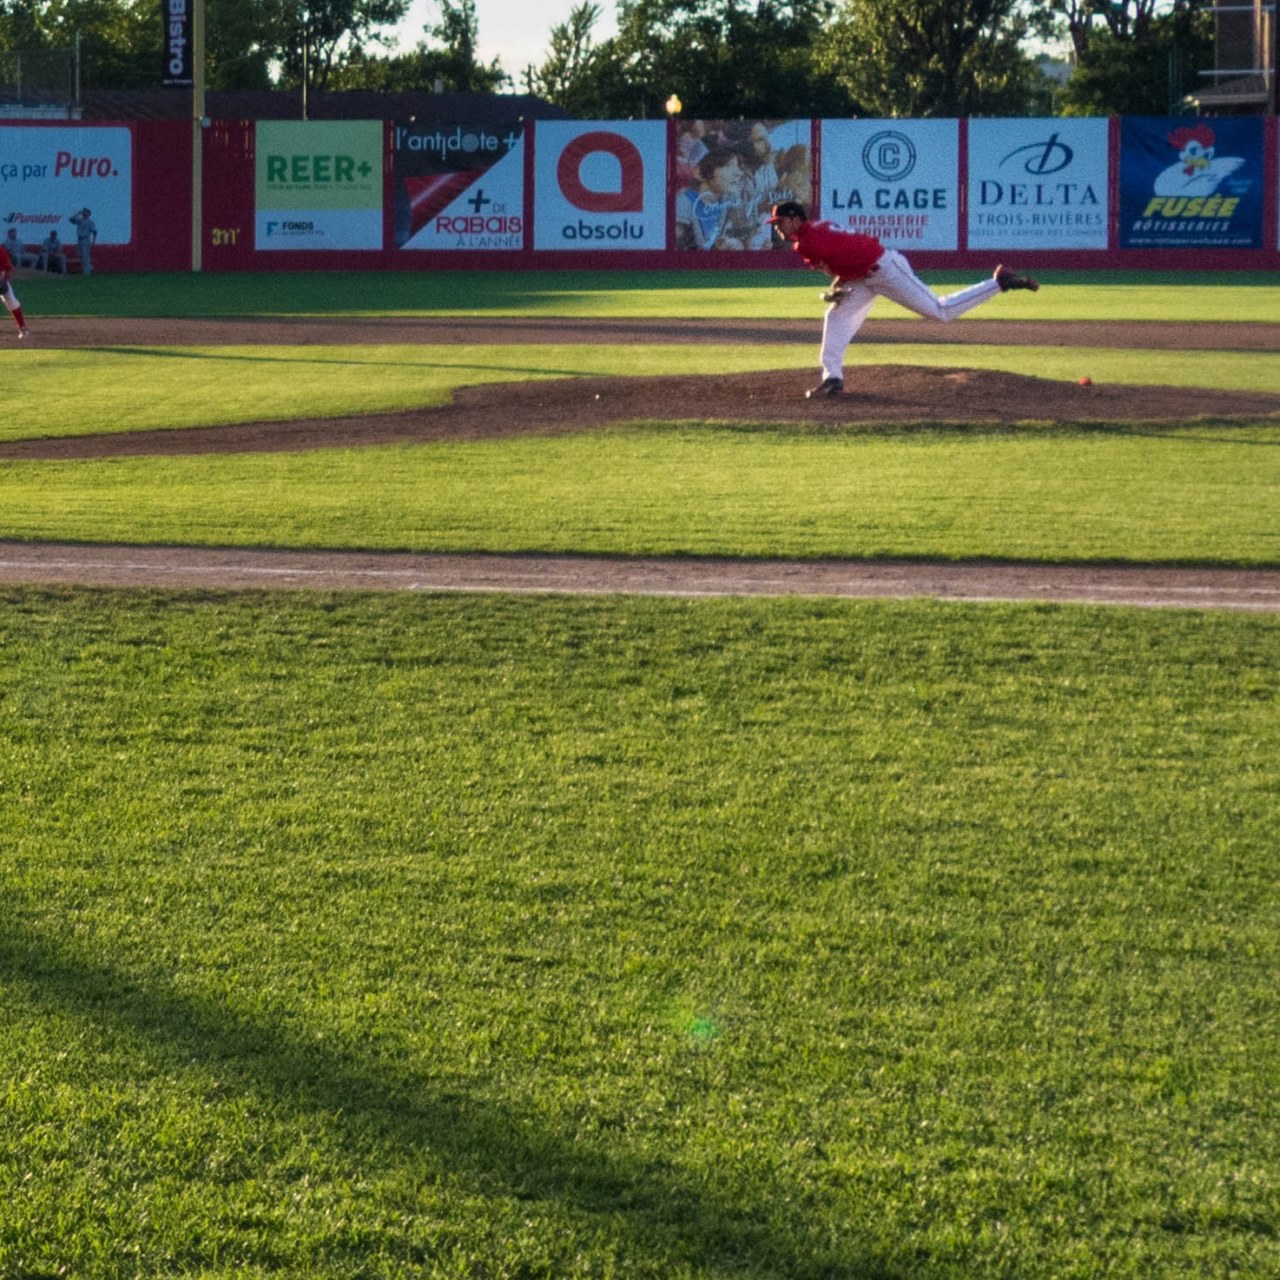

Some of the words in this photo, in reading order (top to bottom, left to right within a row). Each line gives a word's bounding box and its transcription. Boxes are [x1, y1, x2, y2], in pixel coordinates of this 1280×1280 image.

[1, 162, 20, 181] ça
[22, 163, 48, 182] par
[54, 150, 120, 178] Puro.
[267, 155, 372, 183] REER+
[832, 189, 863, 209] LA
[875, 189, 948, 209] CAGE
[980, 181, 1101, 205] DELTA
[493, 203, 507, 214] DE
[1143, 193, 1240, 217] FUSÉE
[14, 212, 63, 224] Purolator
[282, 221, 315, 231] FONDS
[848, 215, 929, 226] BRASSERIE
[978, 210, 1103, 226] TROIS-RIVIÈRES
[562, 220, 644, 239] absolu
